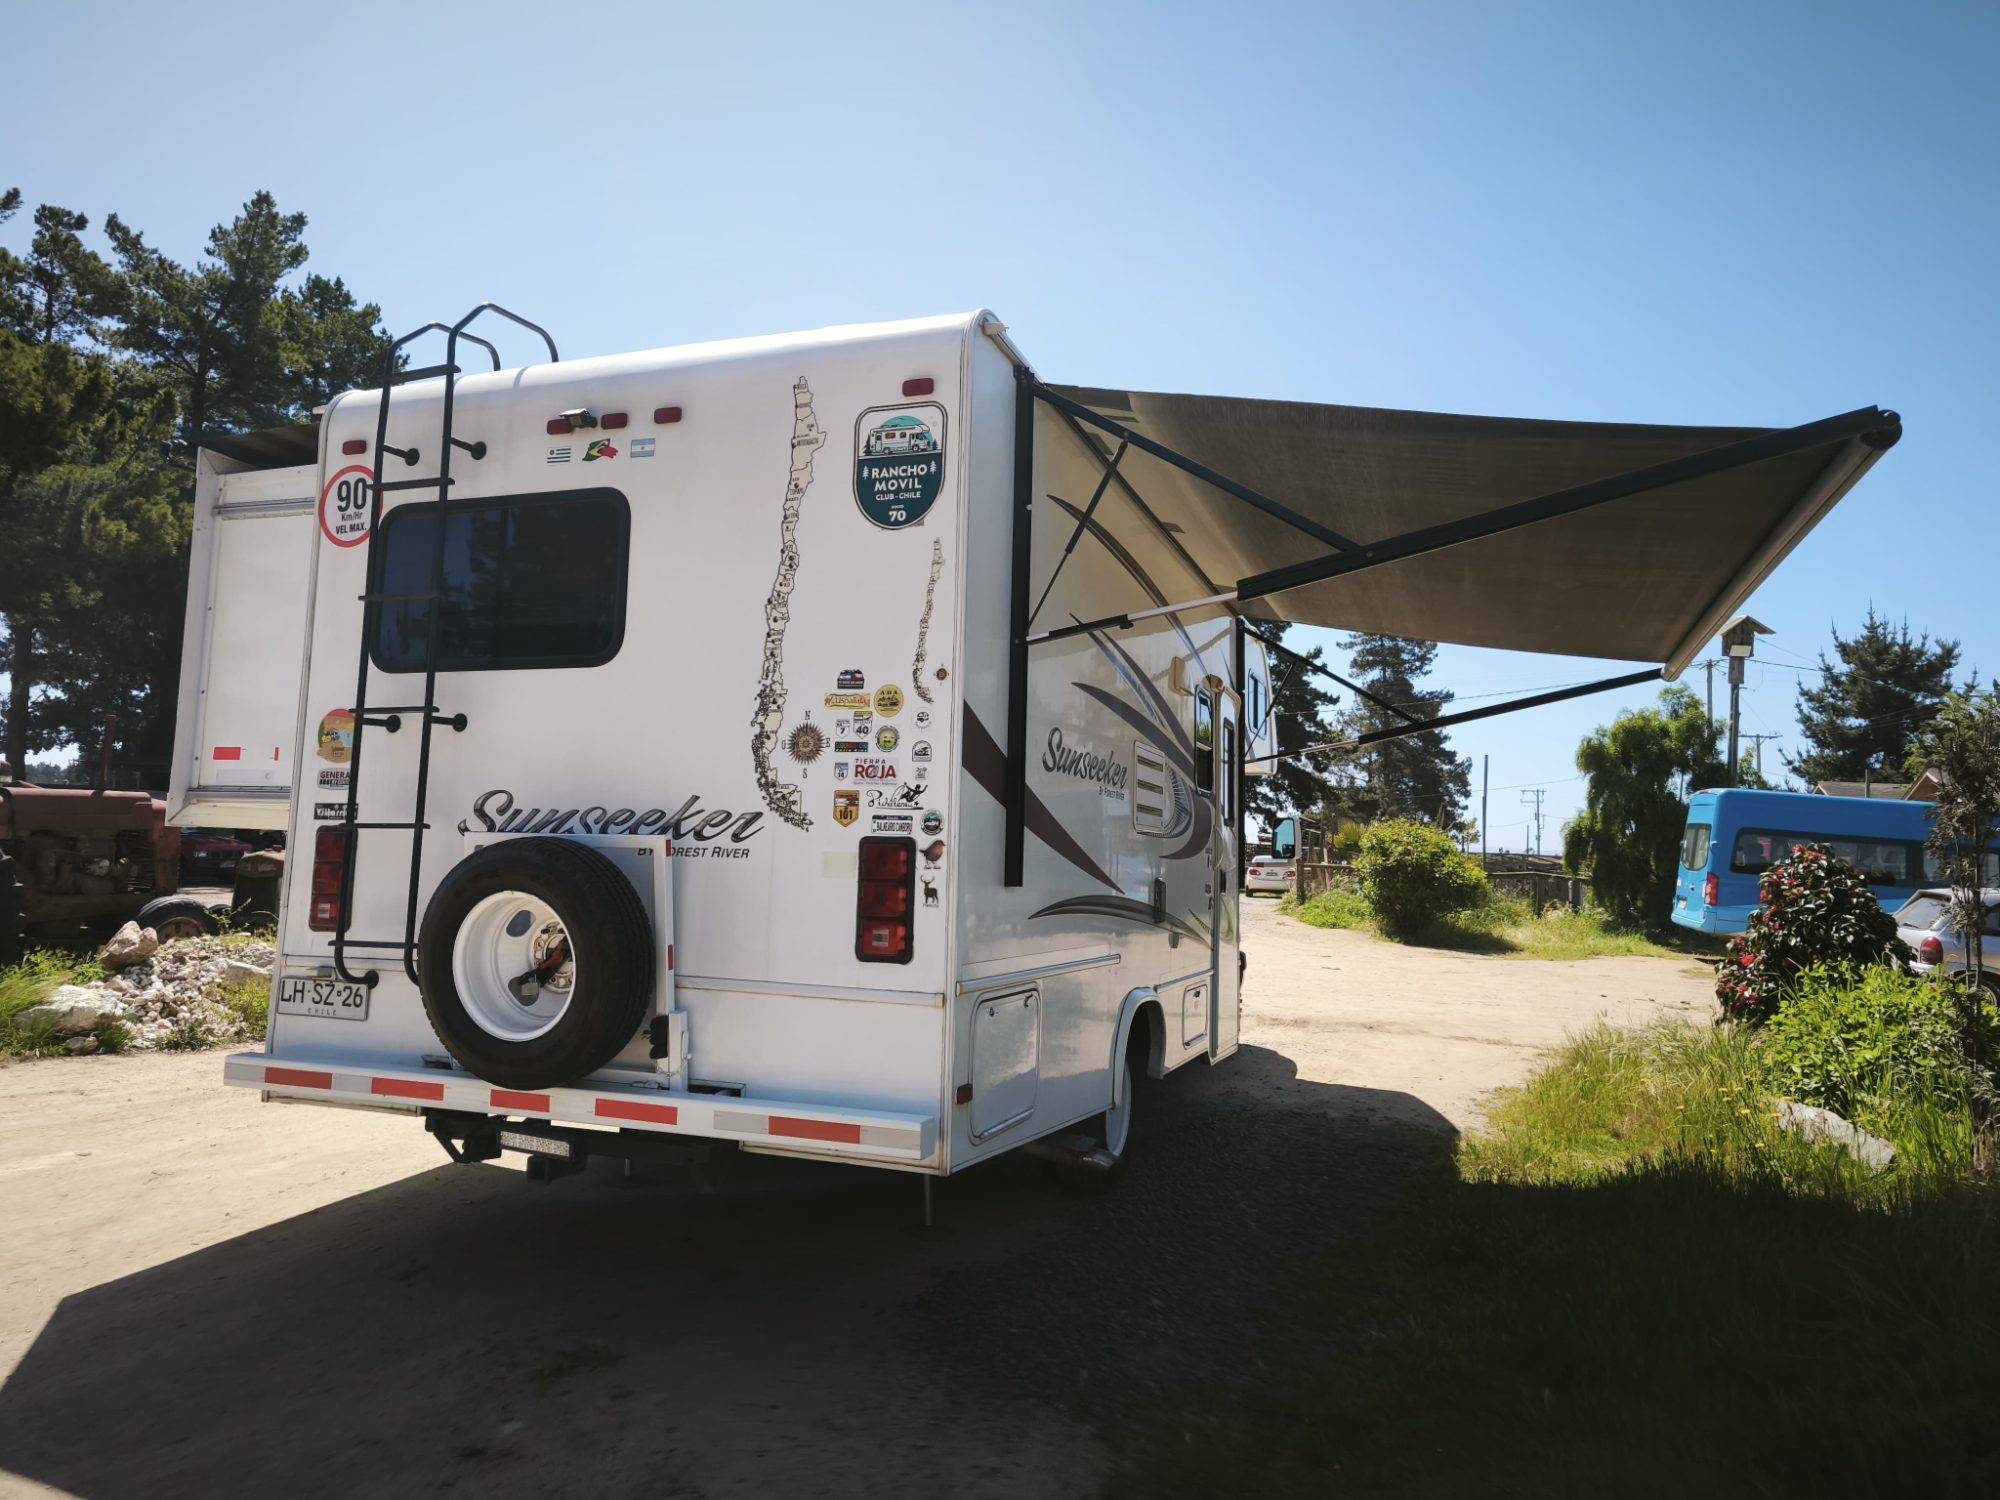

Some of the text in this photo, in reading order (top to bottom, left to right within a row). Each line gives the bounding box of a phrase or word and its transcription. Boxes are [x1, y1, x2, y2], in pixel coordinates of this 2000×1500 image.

[871, 464, 928, 480] RANCHO
[874, 478, 922, 492] MOVIL
[337, 478, 367, 512] 90
[875, 493, 894, 501] CLUB
[899, 491, 921, 499] CHILE
[341, 511, 363, 522] Km/Hr
[888, 511, 907, 522] 70
[335, 522, 367, 535] VEL MAX.
[840, 727, 845, 735] 7
[856, 725, 869, 735] 40
[1042, 727, 1128, 789] Sunseeker
[320, 771, 351, 780] GENERA
[854, 764, 897, 780] ROJA
[457, 789, 765, 843] Sunseeker
[839, 809, 853, 820] 101
[671, 847, 709, 858] OREST
[711, 846, 750, 859] RIVER
[307, 1007, 337, 1016] CHILE
